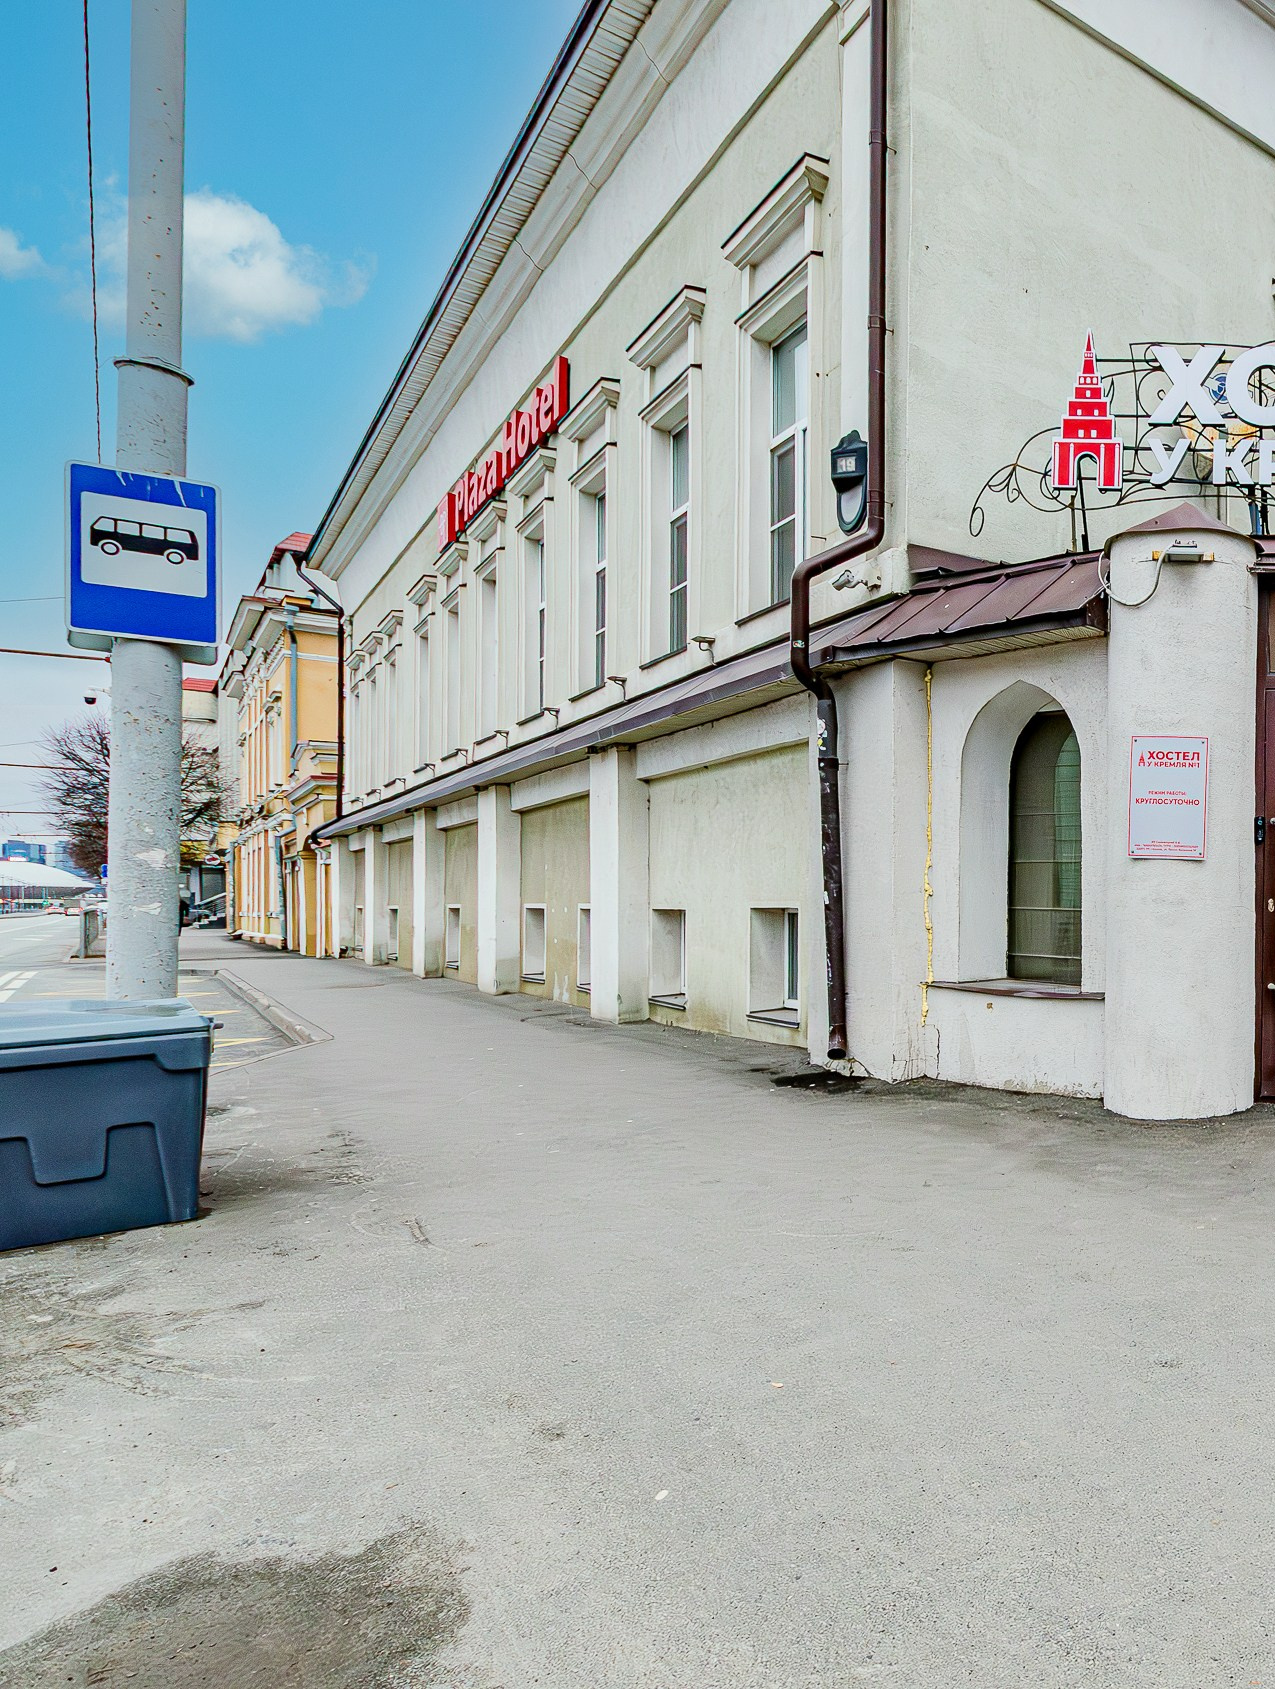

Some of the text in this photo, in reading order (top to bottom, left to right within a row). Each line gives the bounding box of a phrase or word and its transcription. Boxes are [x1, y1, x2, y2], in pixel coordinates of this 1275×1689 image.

[454, 355, 569, 533] Plaza Hotel
[1149, 438, 1193, 487] У
[1147, 750, 1200, 762] ХОСТЕЛ
[1153, 761, 1187, 769] КРЕМЛЯ
[1135, 797, 1200, 806] КРУГЛОСУТОЧНО
